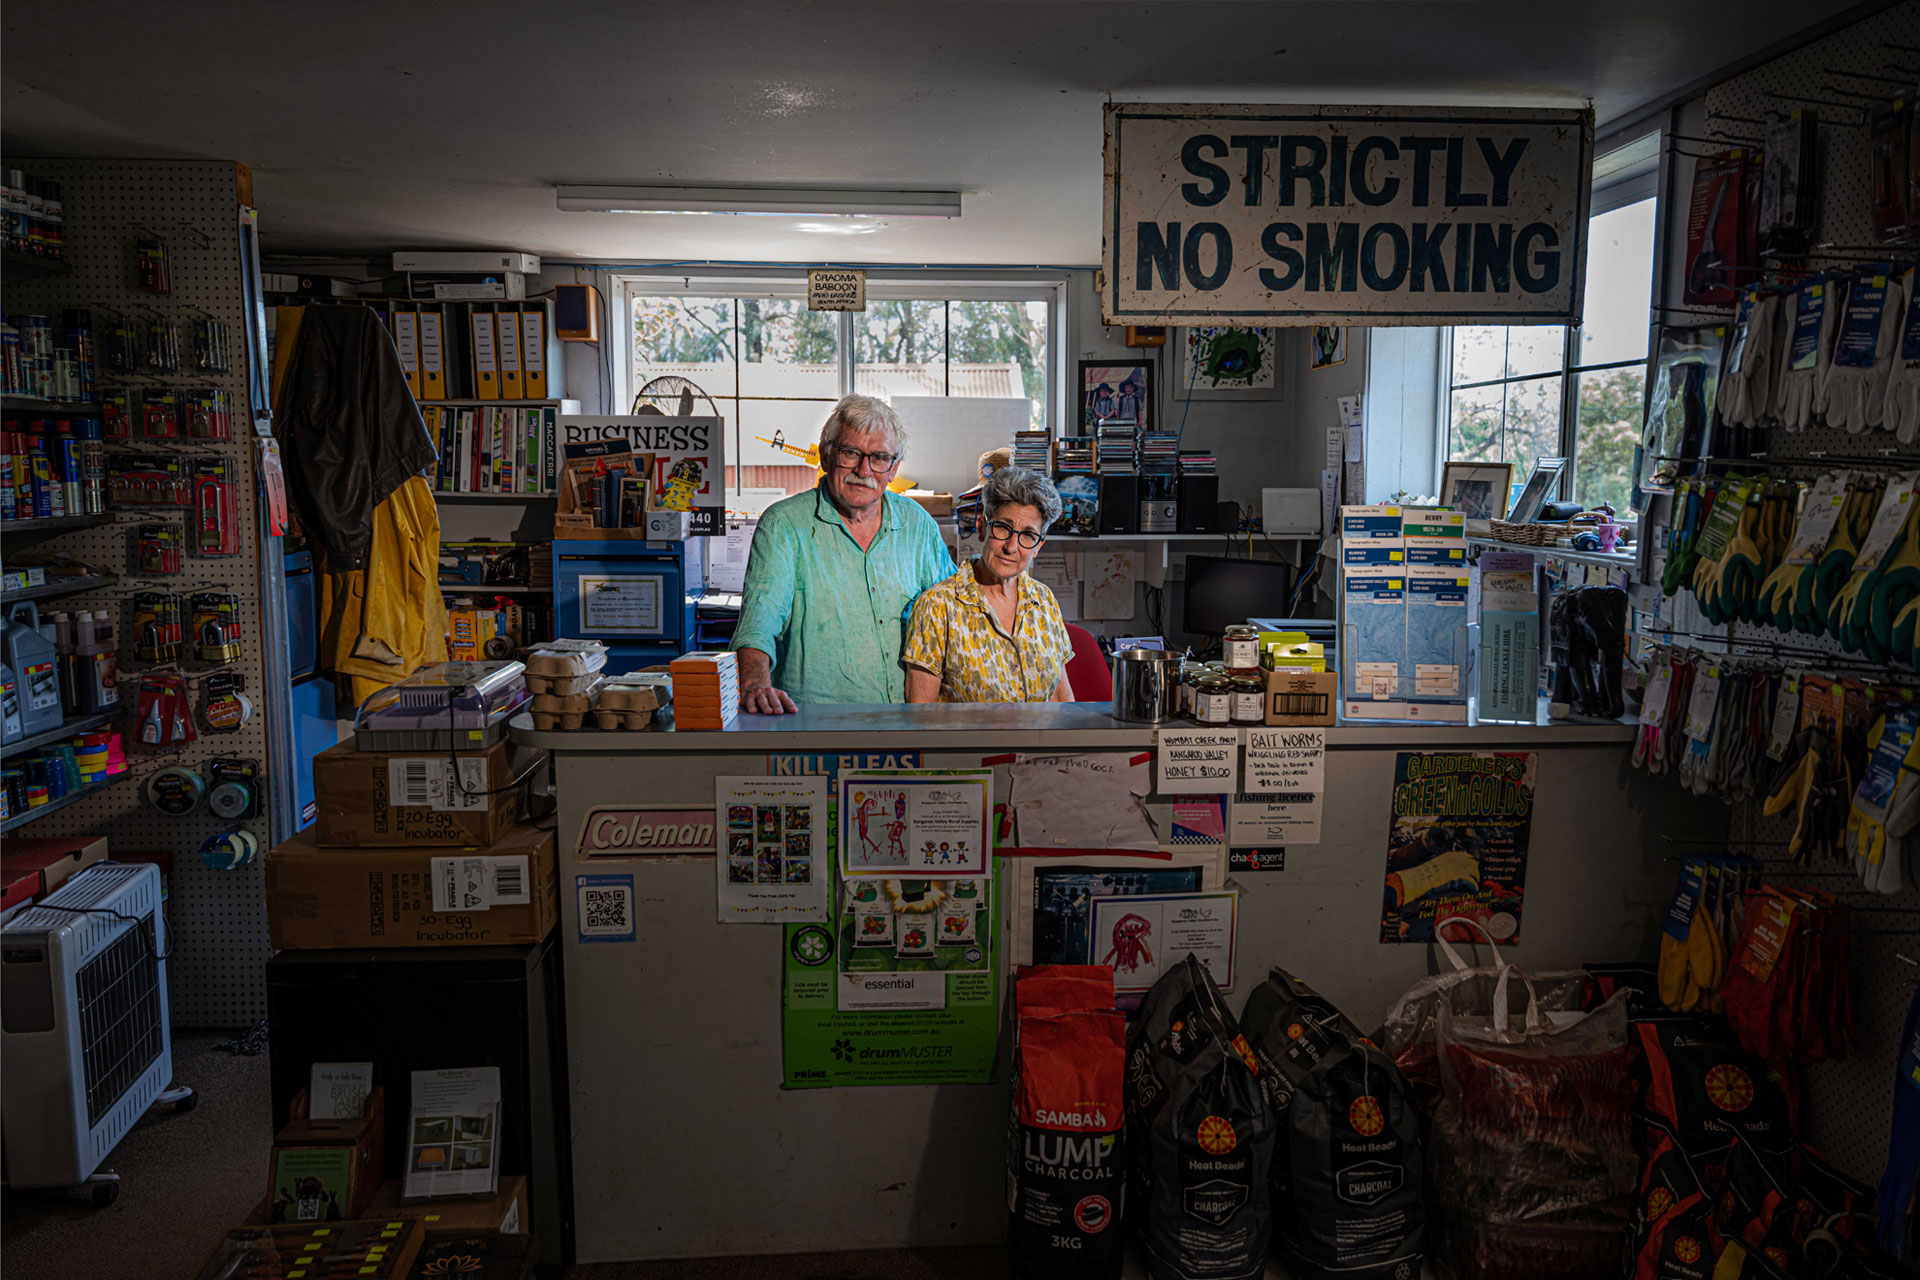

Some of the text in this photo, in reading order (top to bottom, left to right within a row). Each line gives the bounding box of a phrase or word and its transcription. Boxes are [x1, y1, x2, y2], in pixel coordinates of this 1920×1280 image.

[1180, 134, 1530, 207] STRICTLY
[1136, 221, 1561, 292] NO SMOKING
[815, 283, 857, 291] BABOON
[546, 421, 554, 476] MACCAFERRI
[1210, 704, 1228, 712] HONEY
[1164, 736, 1236, 744] WOMBAT CREEK FARM
[1251, 733, 1323, 748] BAIT WORMS
[1170, 751, 1229, 760] KANGAROO VALLEY
[1248, 750, 1286, 759] WRIGGLING
[1287, 750, 1301, 759] RED
[775, 754, 915, 776] KILL FLEAS
[1165, 766, 1196, 778] HONEY
[1407, 755, 1523, 781] GARDENER'S
[1240, 792, 1316, 804] fishing licence
[1394, 775, 1530, 817] GREENnGOLDS
[1268, 804, 1287, 812] here
[405, 811, 423, 823] 20
[426, 811, 452, 828] Egg
[405, 829, 465, 839] Incubator
[592, 815, 715, 850] Coleman
[1259, 852, 1284, 865] agent
[1440, 896, 1461, 905] Them
[1461, 892, 1474, 902] On
[1476, 889, 1493, 899] And
[1419, 910, 1434, 919] Feel
[1436, 906, 1449, 915] The
[446, 914, 472, 930] Egg
[417, 931, 490, 941] Incubator
[866, 979, 915, 990] essential
[859, 1045, 953, 1059] drumMUSTER
[794, 1068, 827, 1079] PRIME
[330, 1087, 366, 1099] BRUSH
[1035, 1109, 1094, 1128] SAMBA
[1024, 1130, 1114, 1168] LUMP
[1342, 1139, 1398, 1152] Heat Beads
[1024, 1160, 1114, 1180] CHARCOAL
[1189, 1158, 1246, 1171] Heat Beads
[1348, 1180, 1393, 1196] CHARCOAL
[1193, 1200, 1237, 1214] CHARCOAL
[1050, 1234, 1082, 1250] 3KG
